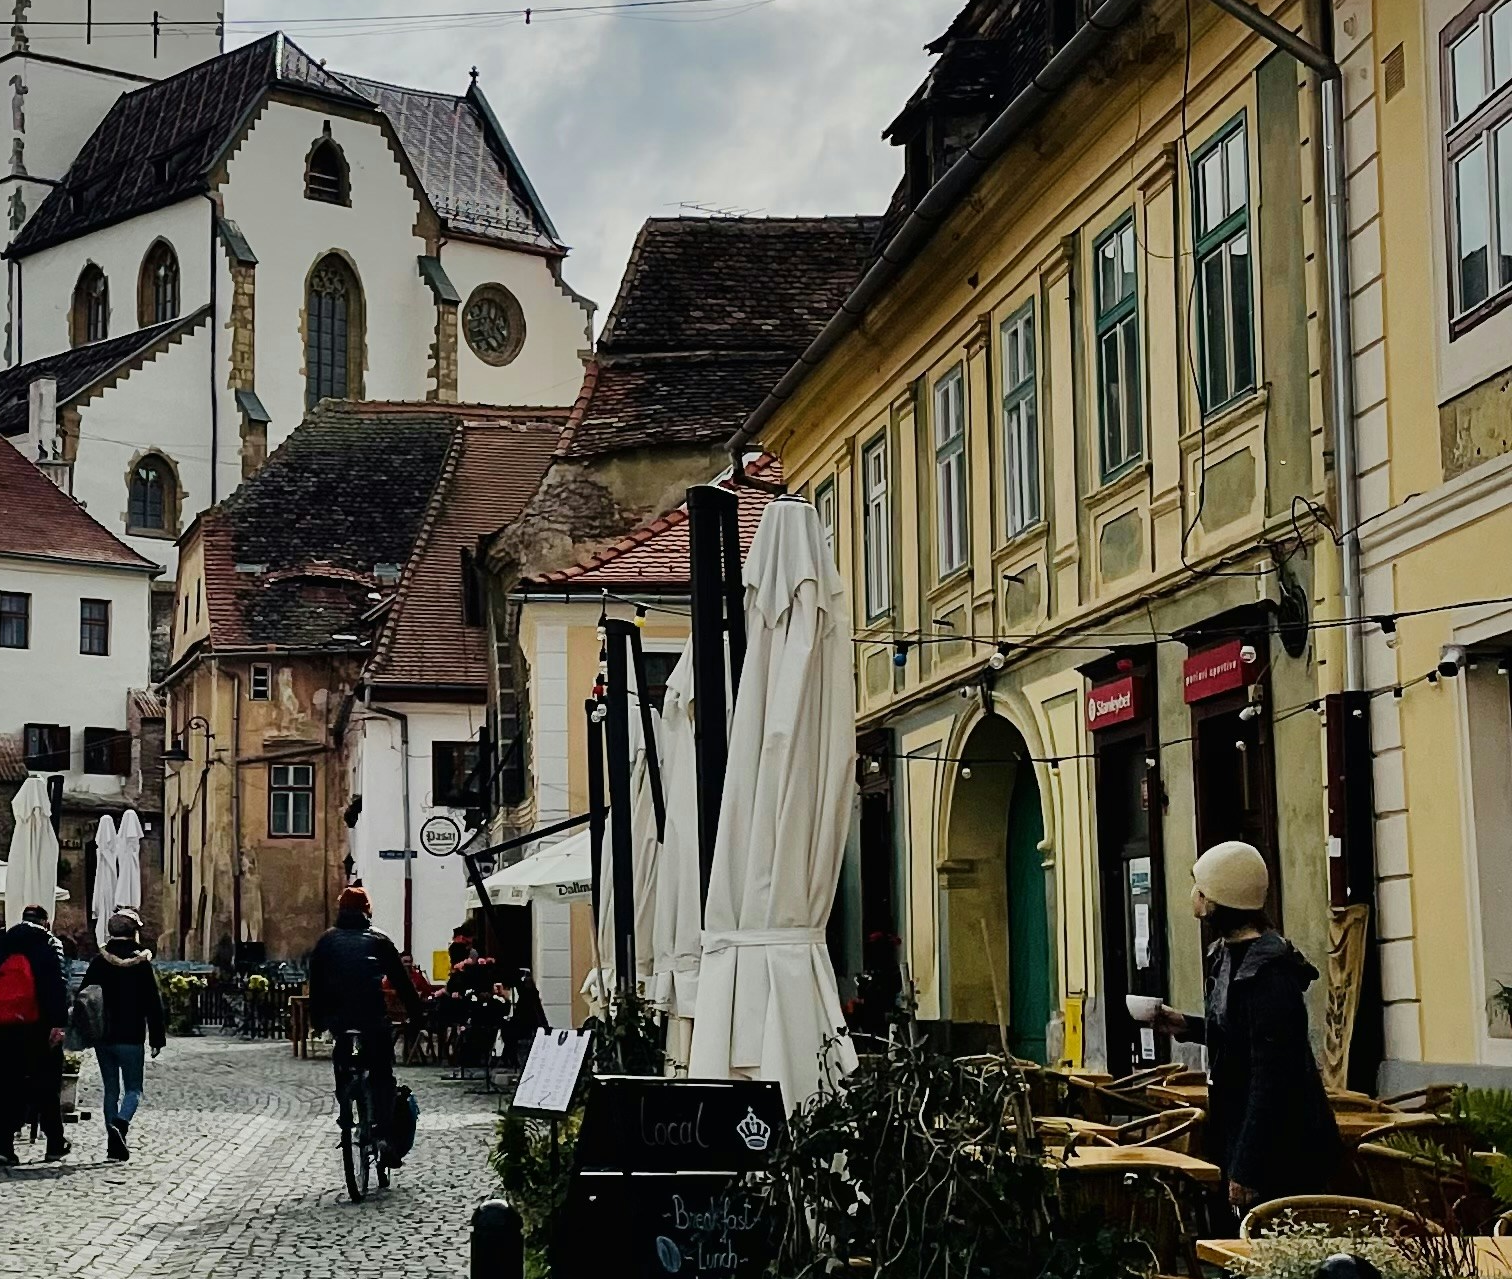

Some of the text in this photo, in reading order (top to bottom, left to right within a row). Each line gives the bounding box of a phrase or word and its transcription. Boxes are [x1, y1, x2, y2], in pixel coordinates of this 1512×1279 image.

[1096, 690, 1131, 717] Stanleybet
[555, 881, 593, 896] Dallm
[698, 1239, 738, 1269] Lunch
